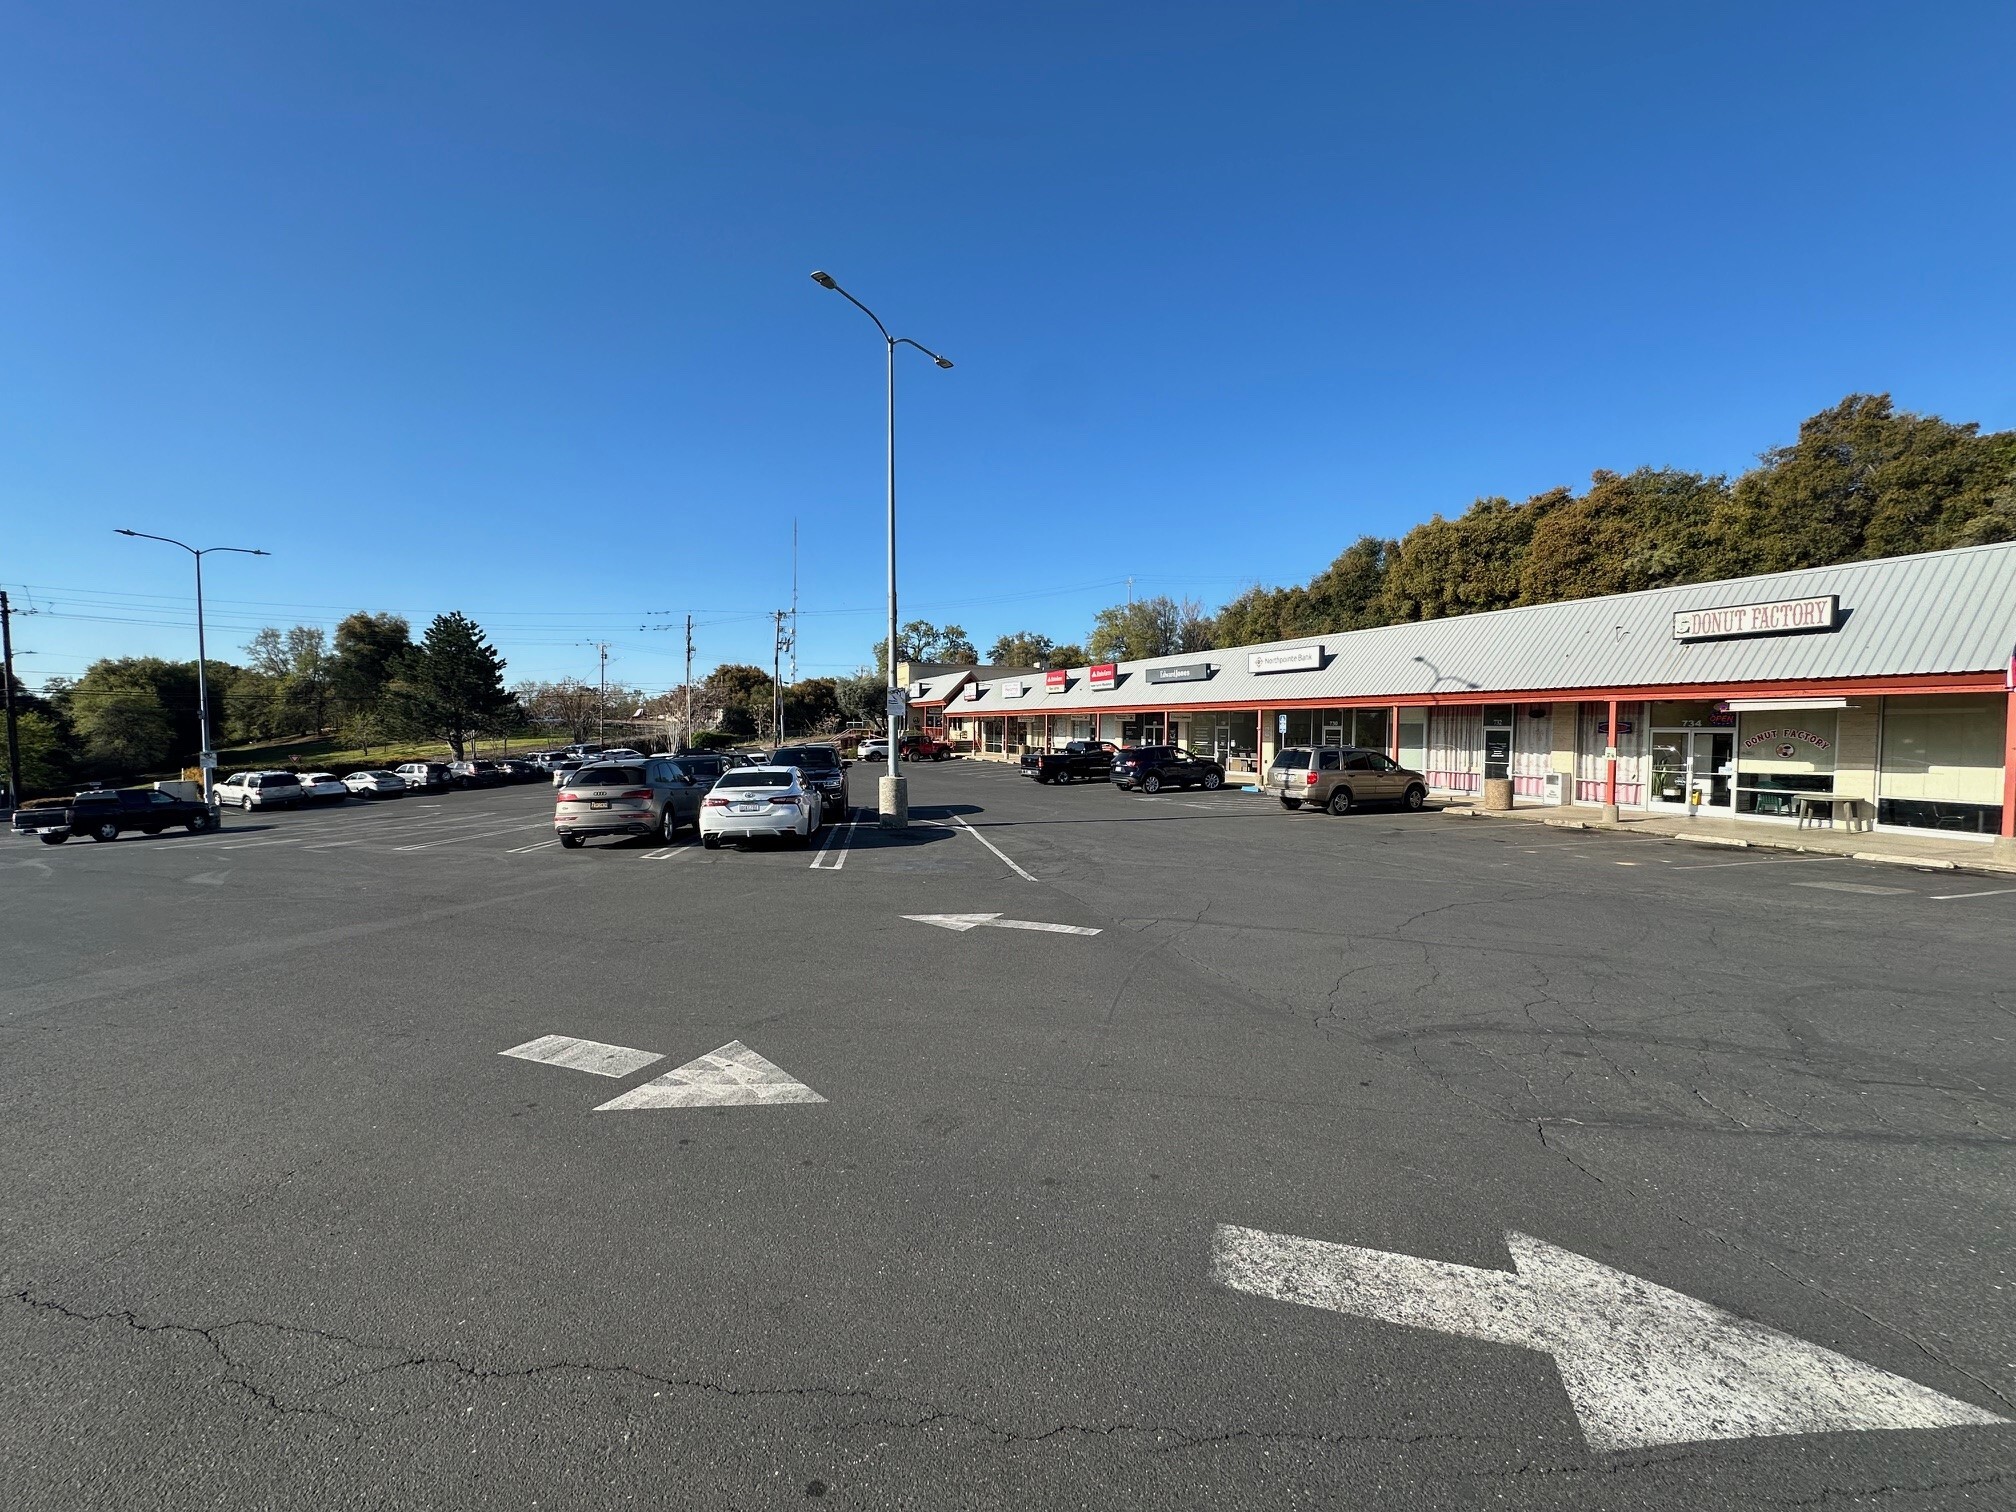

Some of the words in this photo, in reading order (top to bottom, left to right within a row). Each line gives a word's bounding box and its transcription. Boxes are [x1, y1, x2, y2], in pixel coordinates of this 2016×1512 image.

[1691, 609, 1746, 635] DONUT
[1751, 600, 1827, 630] FACTORY
[1265, 654, 1297, 664] Northpointe
[1297, 653, 1313, 662] Bank
[1681, 719, 1702, 727] 734
[1710, 714, 1734, 722] OPEN
[1744, 729, 1778, 748] DONUT
[1783, 728, 1831, 750] FACTORY
